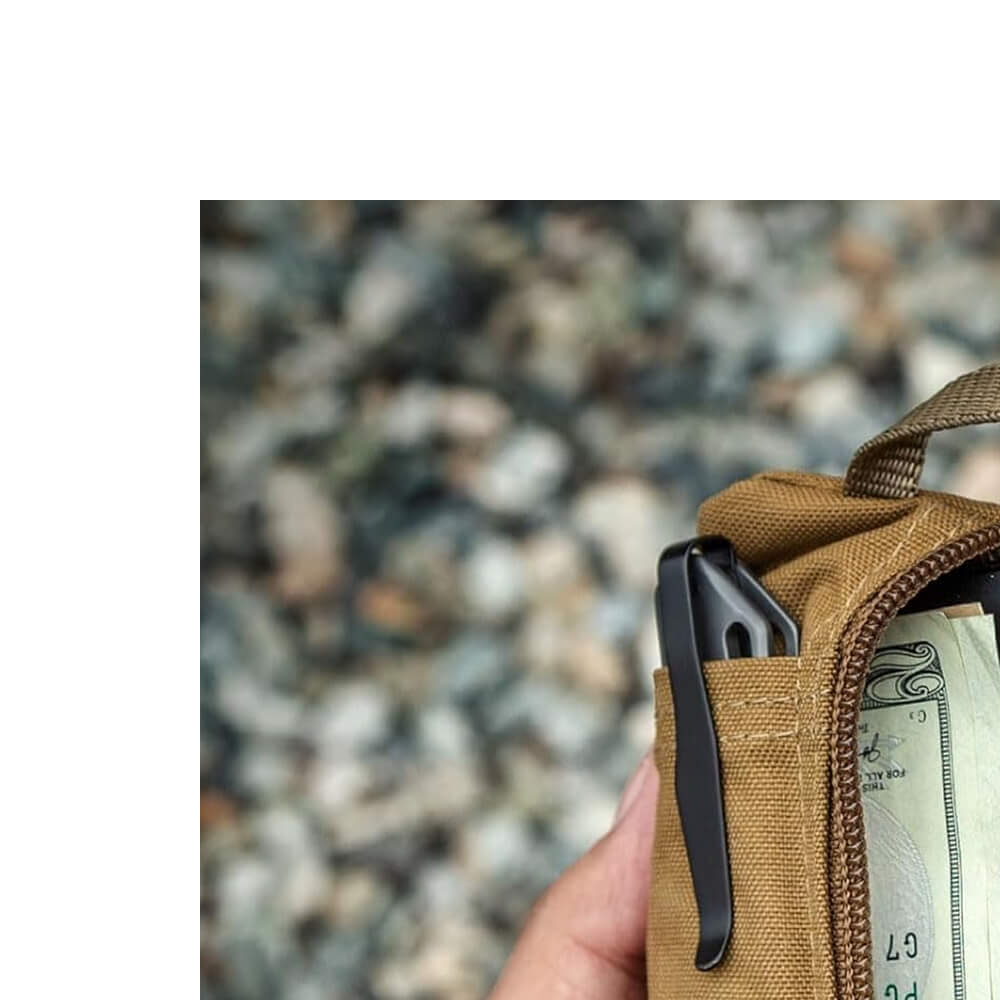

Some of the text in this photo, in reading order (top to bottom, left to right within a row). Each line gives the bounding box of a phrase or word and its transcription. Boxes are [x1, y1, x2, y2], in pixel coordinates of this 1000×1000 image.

[865, 769, 906, 780] FOR ALL
[862, 783, 886, 793] THIS
[885, 932, 918, 961] G7
